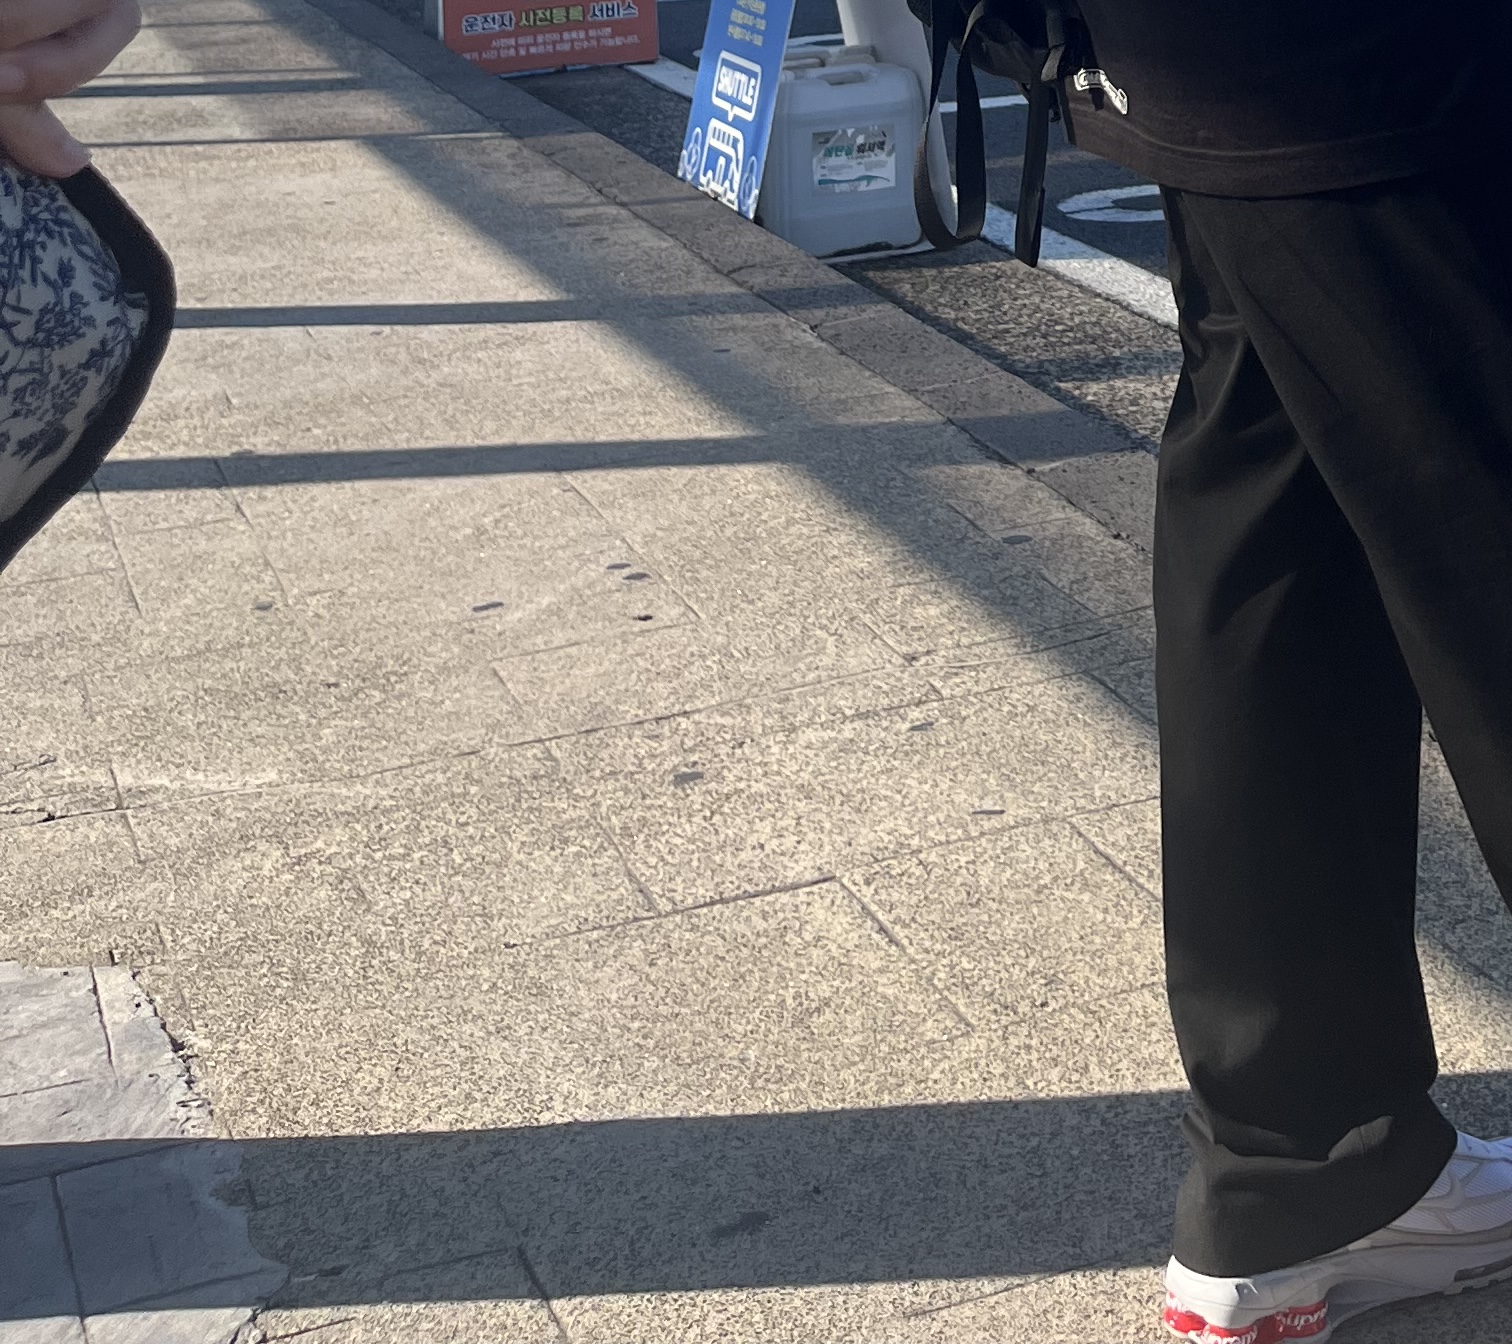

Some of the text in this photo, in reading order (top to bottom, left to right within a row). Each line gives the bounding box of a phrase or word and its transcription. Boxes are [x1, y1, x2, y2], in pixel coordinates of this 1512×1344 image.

[462, 0, 639, 35] 운전자 사전등록 서비스
[717, 64, 756, 108] SHUTTLE
